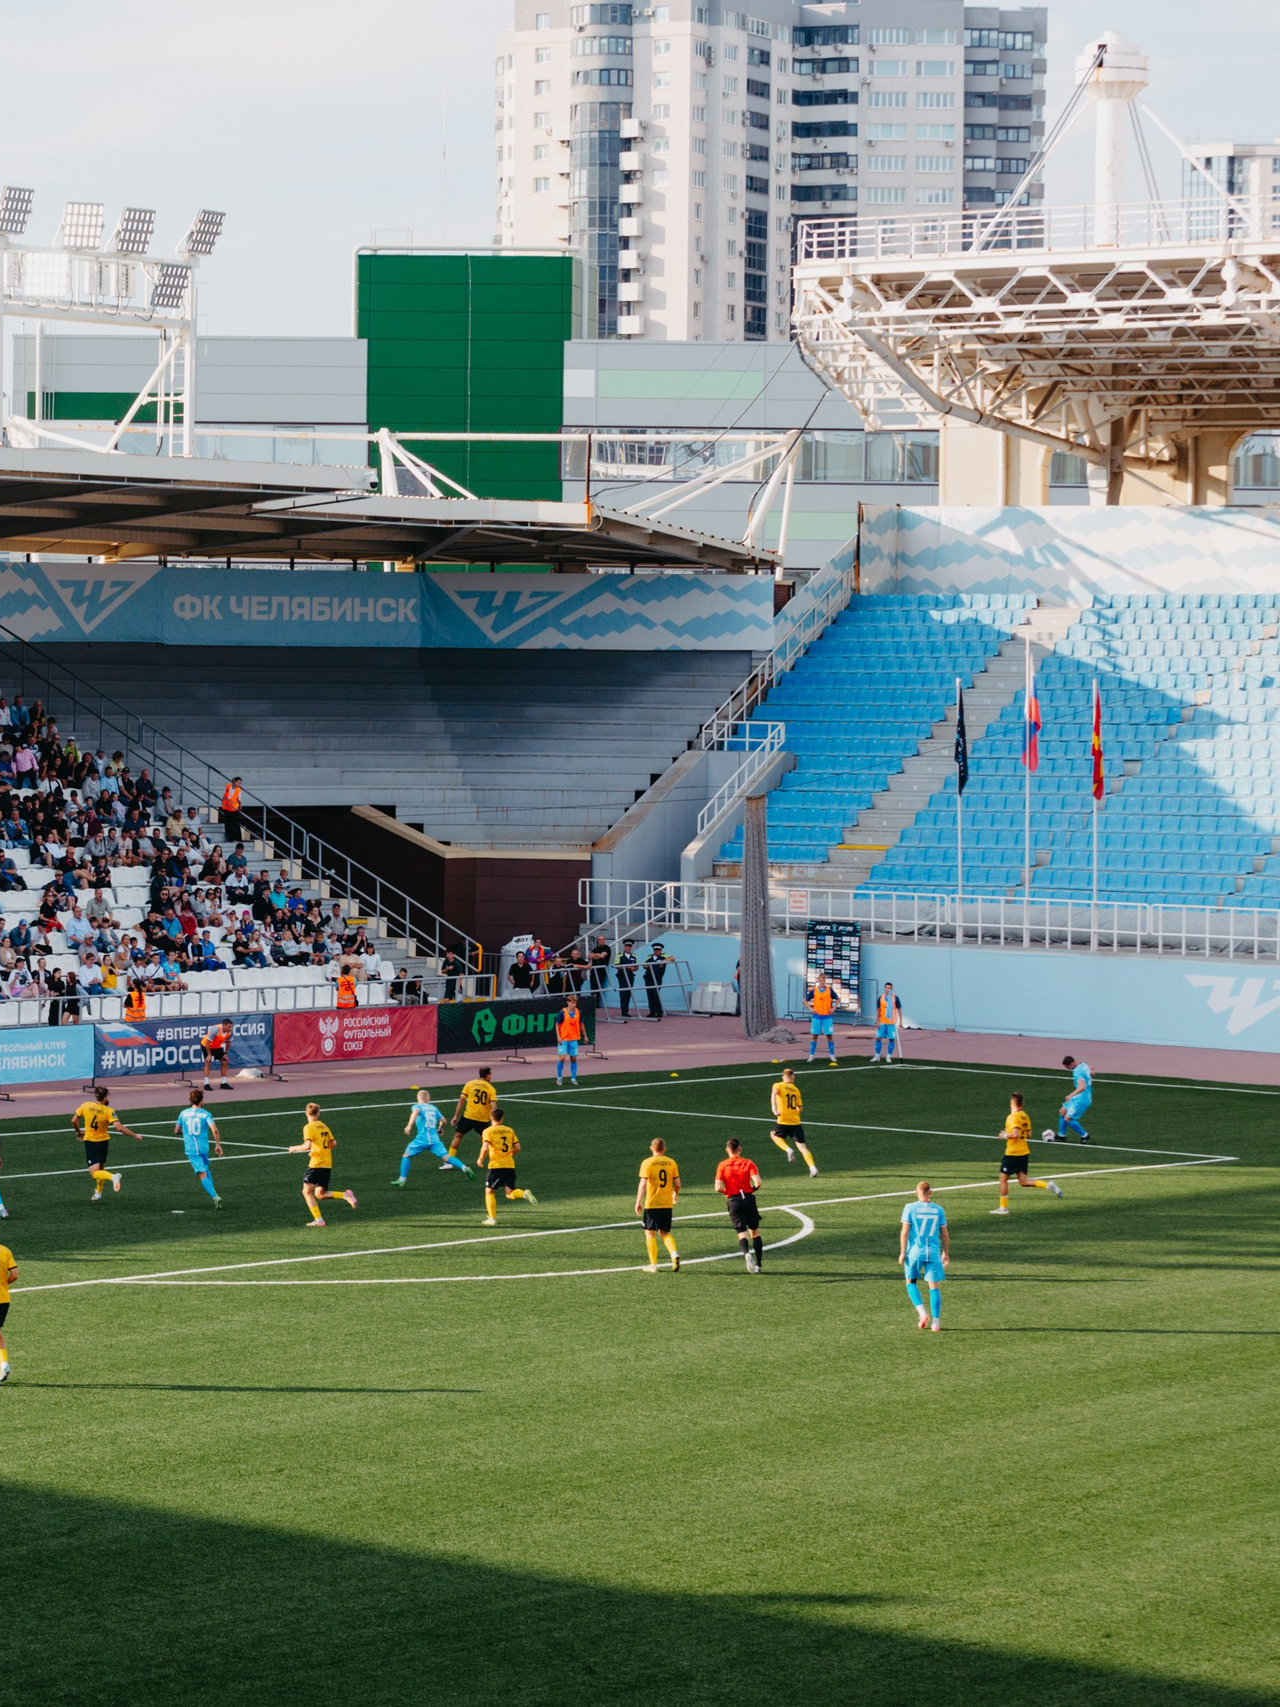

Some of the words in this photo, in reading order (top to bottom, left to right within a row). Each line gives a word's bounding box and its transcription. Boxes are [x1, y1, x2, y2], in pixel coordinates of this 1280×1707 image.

[173, 593, 223, 620] ФК
[229, 596, 419, 623] ЧЕЛЯБИНСК
[343, 1014, 390, 1027] РОССИЙСКИЙ
[156, 1022, 266, 1042] #ВПЕРЕССИЯ
[343, 1026, 392, 1040] ФУТБОЛЬНЫЙ
[44, 1040, 67, 1051] КЛУБ
[343, 1040, 364, 1052] СОЮЗ
[474, 1089, 488, 1106] 30
[785, 1093, 797, 1110] 10
[90, 1115, 99, 1131] 4
[187, 1117, 201, 1136] 10
[500, 1136, 509, 1153] 3
[658, 1169, 668, 1188] 9
[916, 1215, 939, 1237] 77
